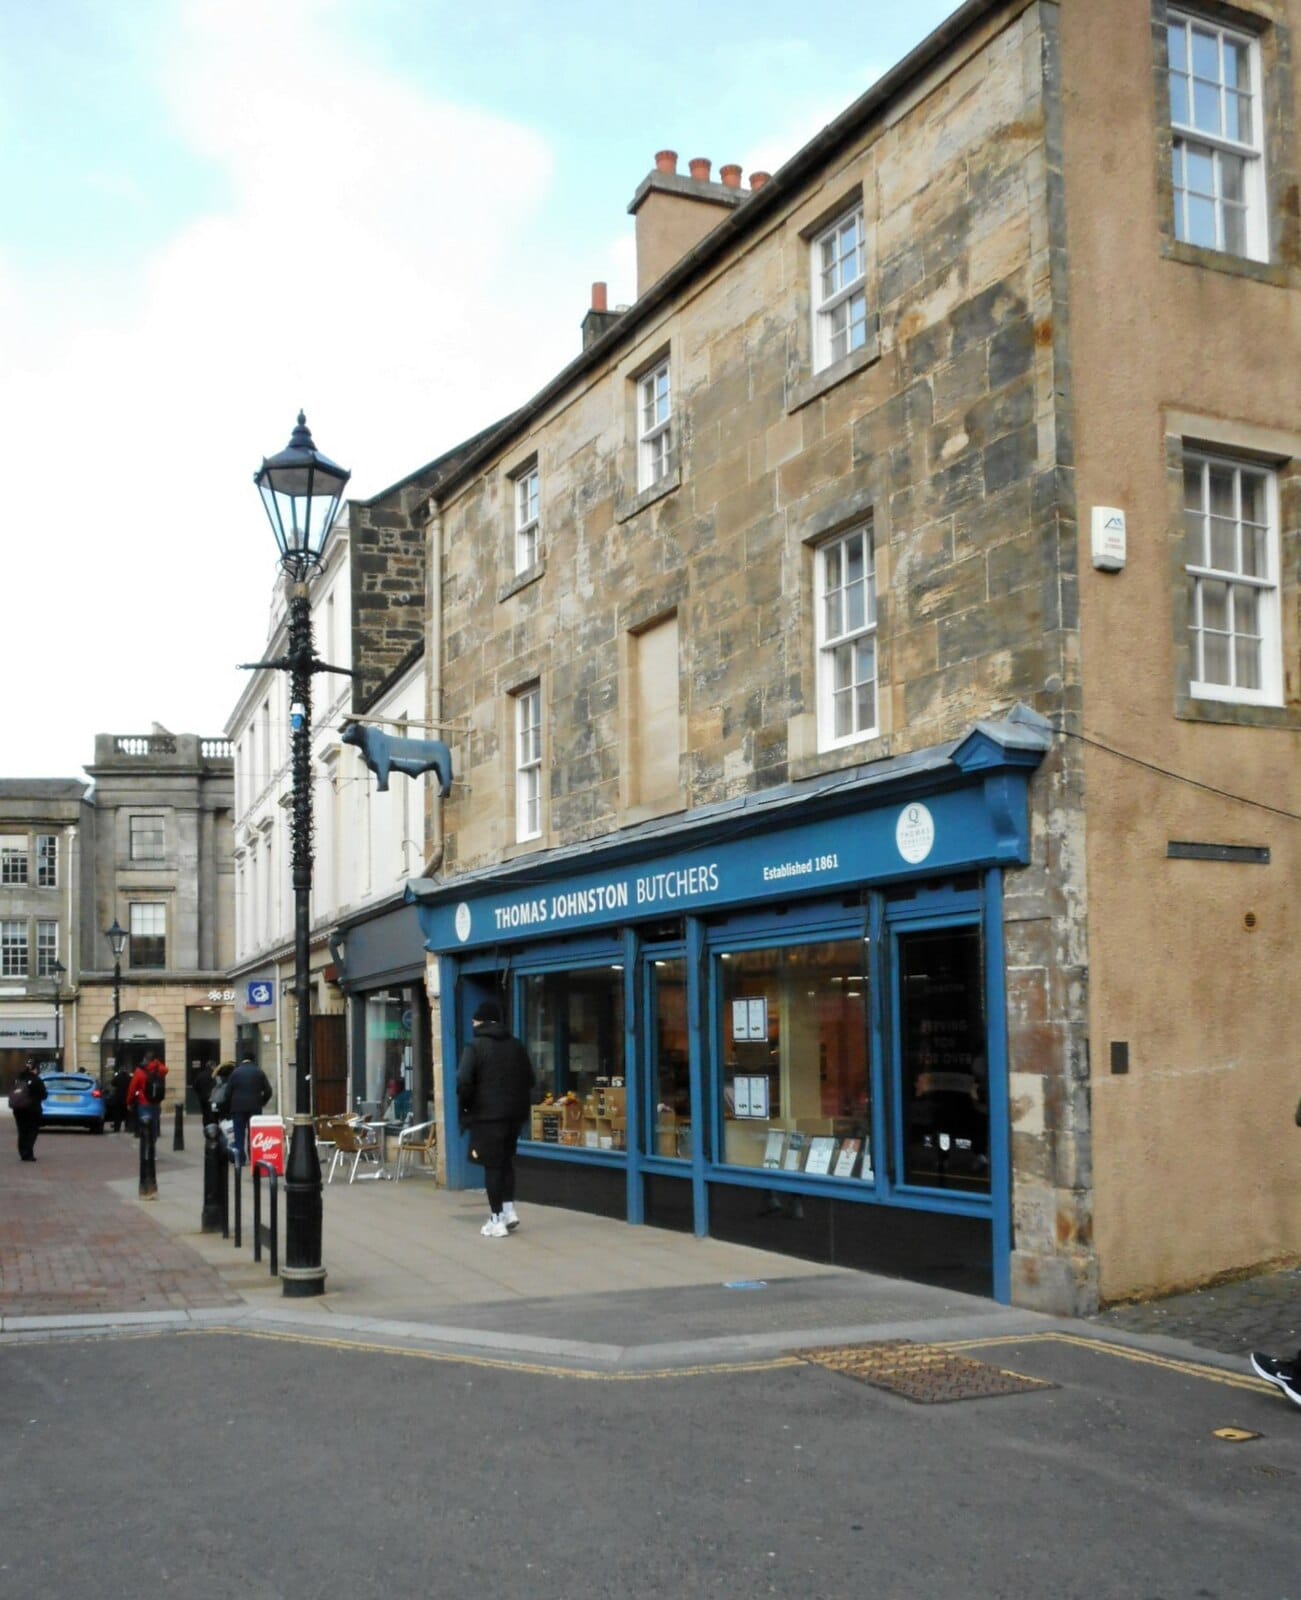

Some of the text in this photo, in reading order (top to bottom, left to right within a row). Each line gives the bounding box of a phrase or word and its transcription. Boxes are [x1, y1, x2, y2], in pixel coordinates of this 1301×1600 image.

[763, 854, 839, 881] Established 1861
[494, 899, 547, 930] THOMAS
[549, 882, 628, 919] JOHNSTON
[636, 863, 719, 904] BUTCHERS
